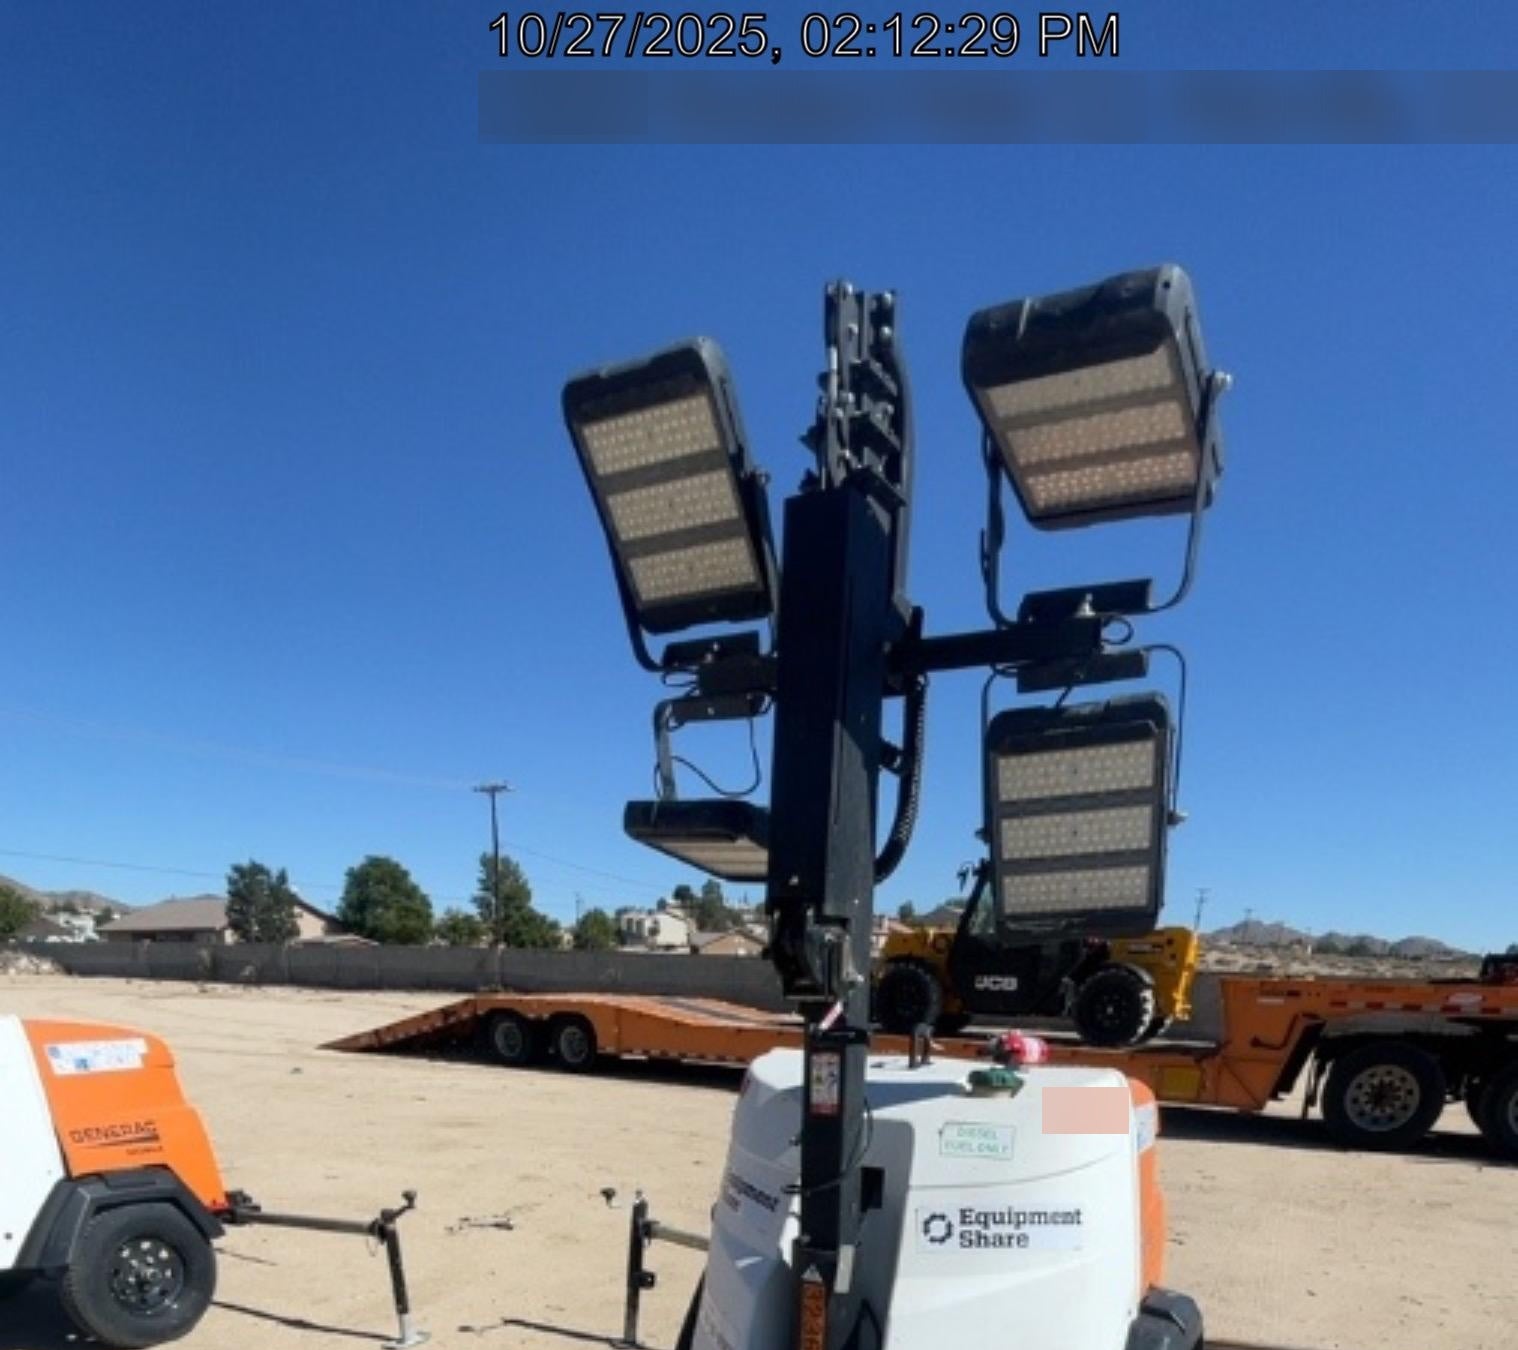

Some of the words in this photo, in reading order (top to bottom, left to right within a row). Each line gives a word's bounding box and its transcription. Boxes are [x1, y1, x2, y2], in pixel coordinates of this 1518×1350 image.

[974, 976, 1018, 991] JCB
[959, 1206, 1082, 1230] Equipment
[959, 1229, 1029, 1248] Share
